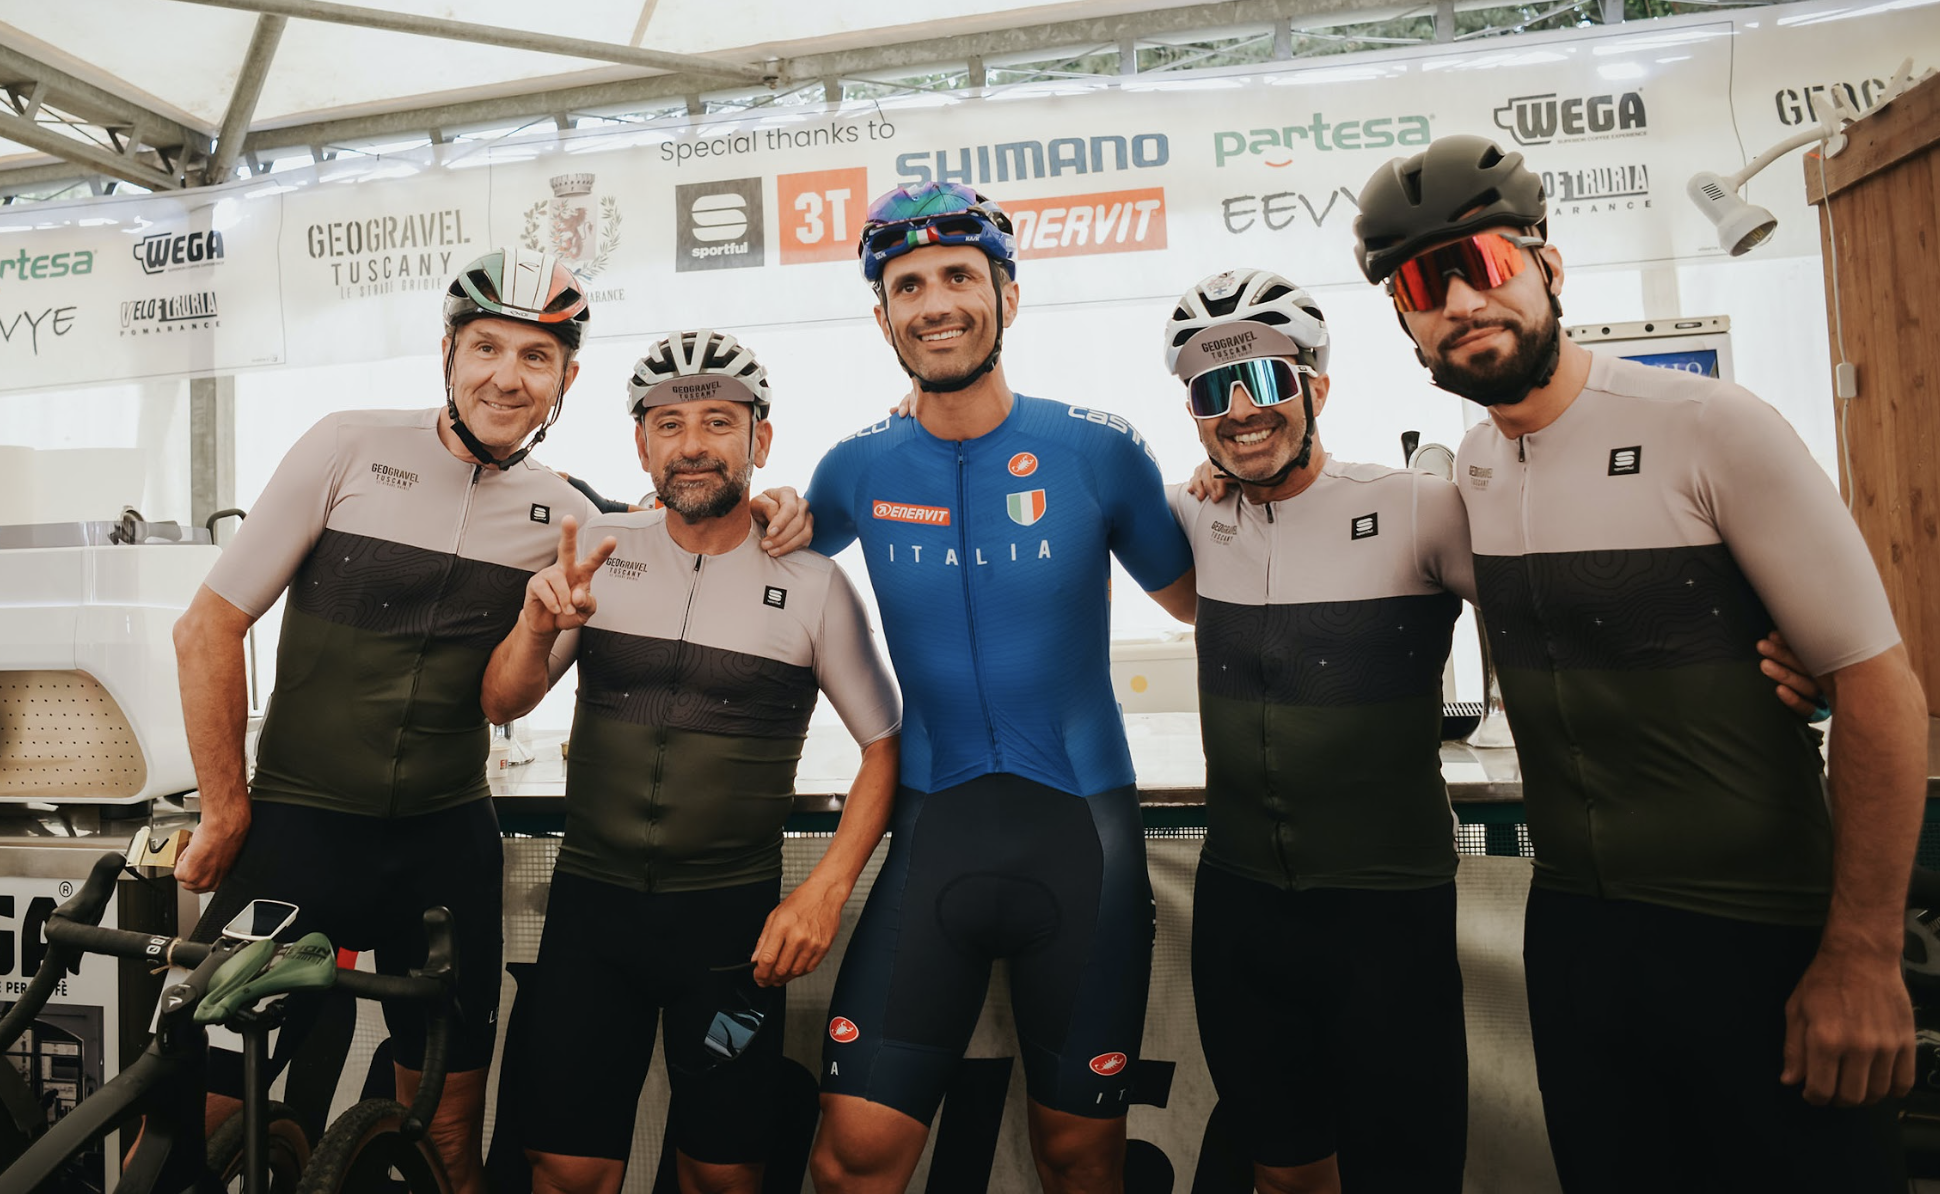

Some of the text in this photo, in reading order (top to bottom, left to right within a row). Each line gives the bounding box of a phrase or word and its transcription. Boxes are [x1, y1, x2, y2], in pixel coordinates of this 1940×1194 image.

[1516, 92, 1647, 139] WEGA
[660, 120, 896, 167] Special thanks to
[1214, 112, 1431, 167] partesa
[1587, 134, 1609, 142] COFFEE
[1611, 131, 1648, 139] EXPERIENCE
[895, 133, 1169, 187] SHIMANO
[794, 188, 851, 244] 3T
[1008, 199, 1161, 250] NERVIT
[308, 209, 470, 259] GEOGRAVEL
[145, 230, 224, 269] WEGA
[691, 242, 749, 259] sportful
[331, 252, 453, 286] TUSCANY
[401, 277, 442, 292] GRIGIE
[120, 321, 221, 337] POMARANCE
[1201, 331, 1258, 353] GEOGRAVEL
[1211, 343, 1252, 359] TUSCANY
[672, 381, 721, 393] GEOGRAVEL
[679, 390, 716, 399] TUSCANY
[371, 463, 419, 483] GEOGRAVEL
[376, 474, 412, 487] TUSCANY
[890, 505, 948, 523] ENERVIT
[889, 540, 1051, 566] ITALIA
[606, 557, 648, 573] GEOGRAVEL
[610, 567, 641, 578] TUSCANY
